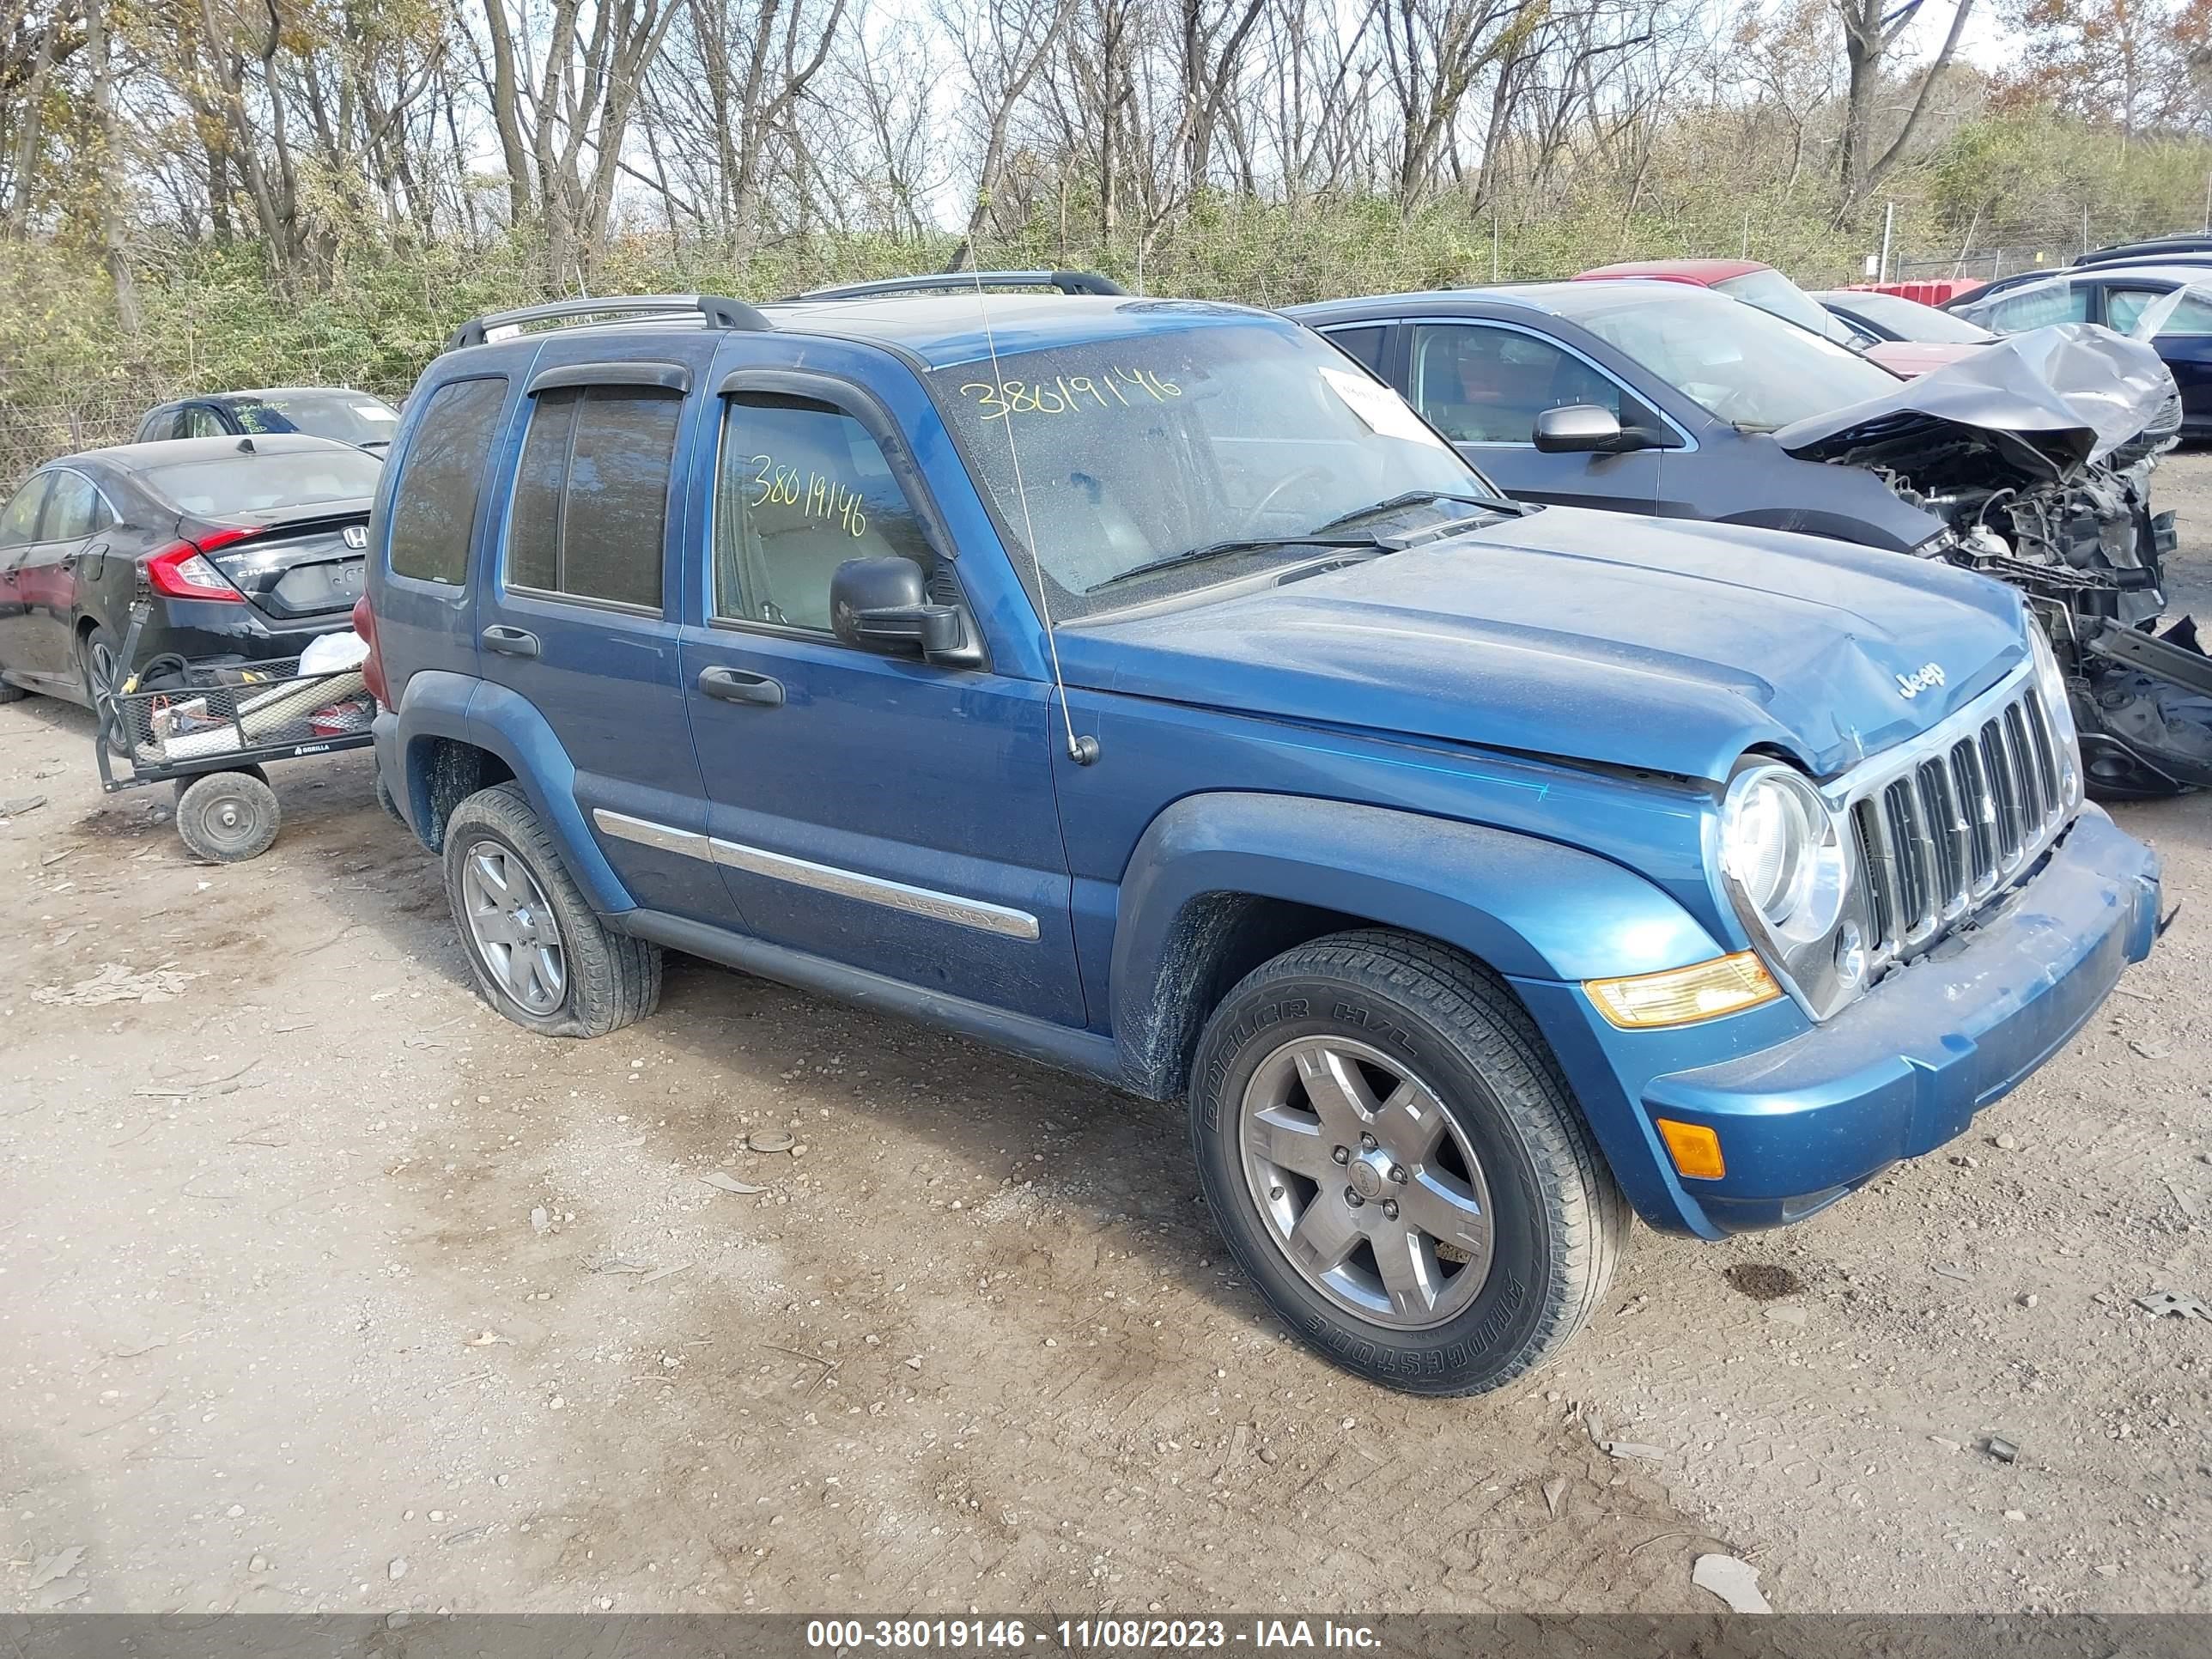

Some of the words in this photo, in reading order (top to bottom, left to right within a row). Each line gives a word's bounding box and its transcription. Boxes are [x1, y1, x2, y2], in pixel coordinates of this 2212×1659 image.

[959, 365, 1182, 420] 38019146
[750, 454, 866, 538] 38019146
[1895, 662, 1945, 700] Jeep
[302, 744, 330, 753] GORILLA
[895, 895, 999, 927] LIBERTY
[1304, 1267, 1526, 1376] BRIDGESTONE
